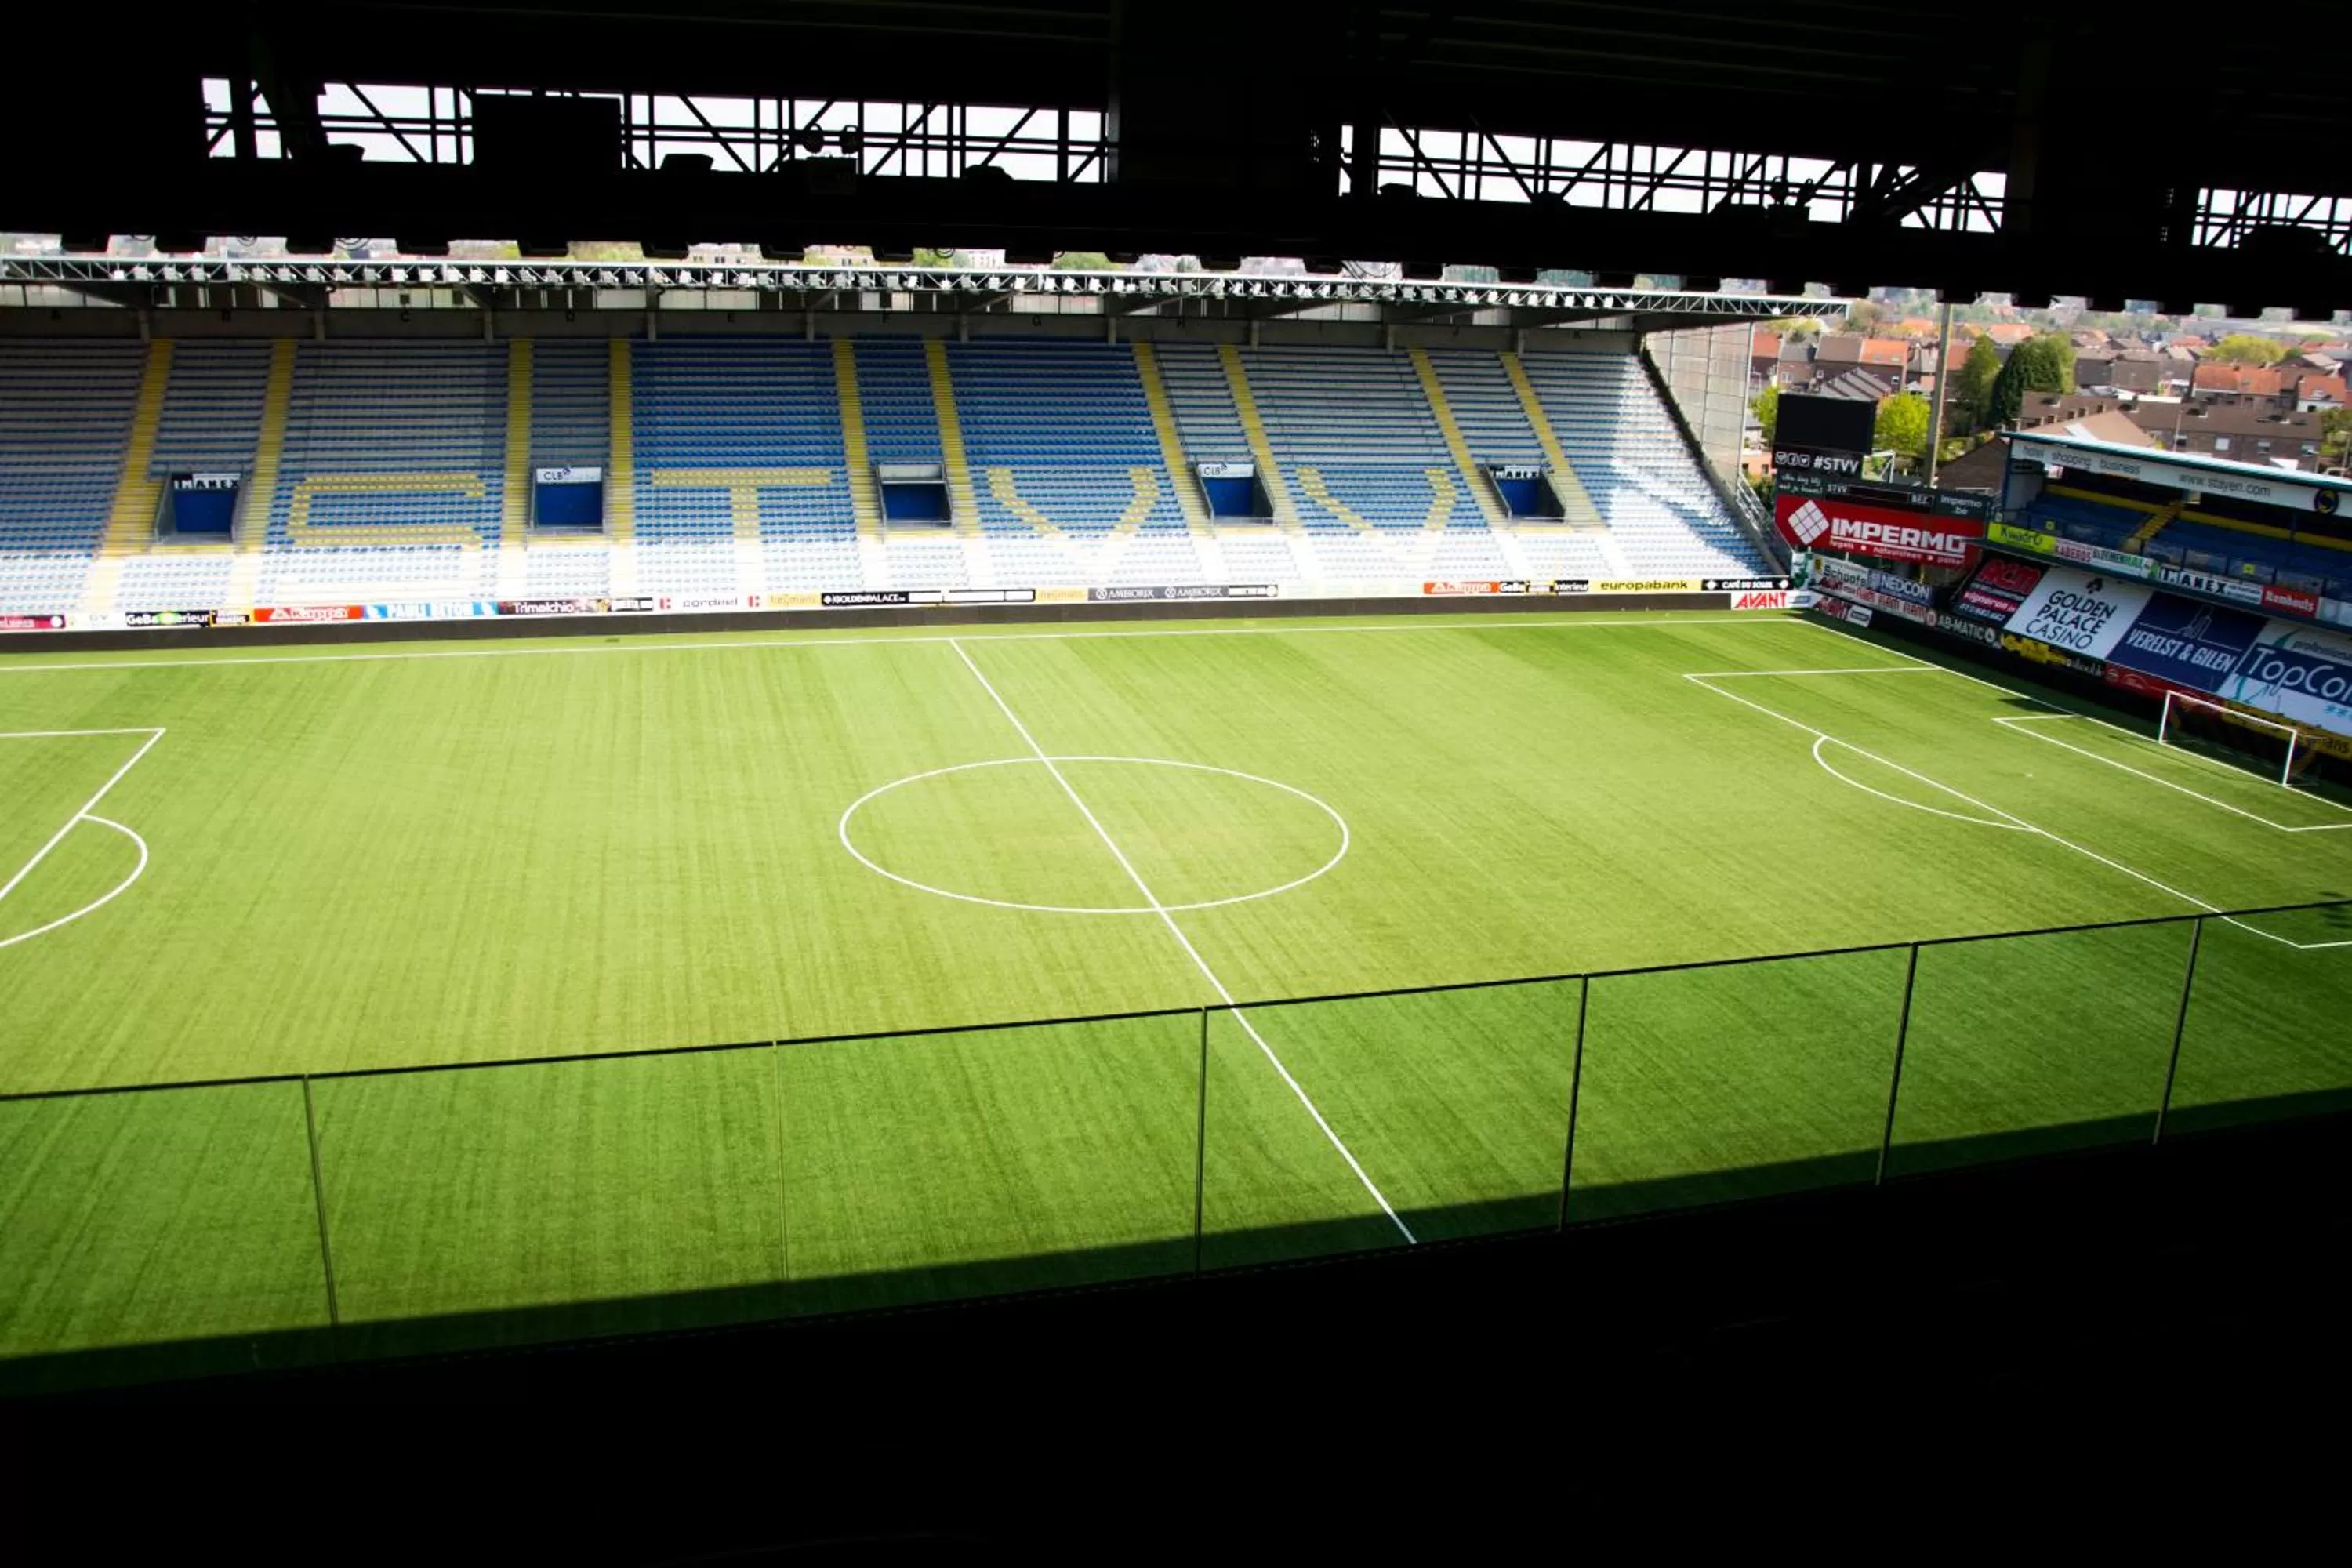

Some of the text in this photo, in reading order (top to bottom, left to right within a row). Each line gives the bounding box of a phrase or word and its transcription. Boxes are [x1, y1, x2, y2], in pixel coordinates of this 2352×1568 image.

[1813, 456, 1859, 474] #STVV
[2051, 451, 2092, 470] shopping
[2099, 456, 2142, 475] business
[1831, 517, 1967, 554] IMPERMO
[1600, 580, 1688, 595] europabank
[1880, 574, 1930, 600] NEDCON
[2160, 566, 2228, 595] IMANEX
[1733, 593, 1787, 609] AVANT
[2049, 590, 2118, 619] GOLDEN
[2026, 619, 2094, 650] CASINO
[2037, 604, 2107, 636] PALACE
[2125, 628, 2237, 673] VERELST & GILEN
